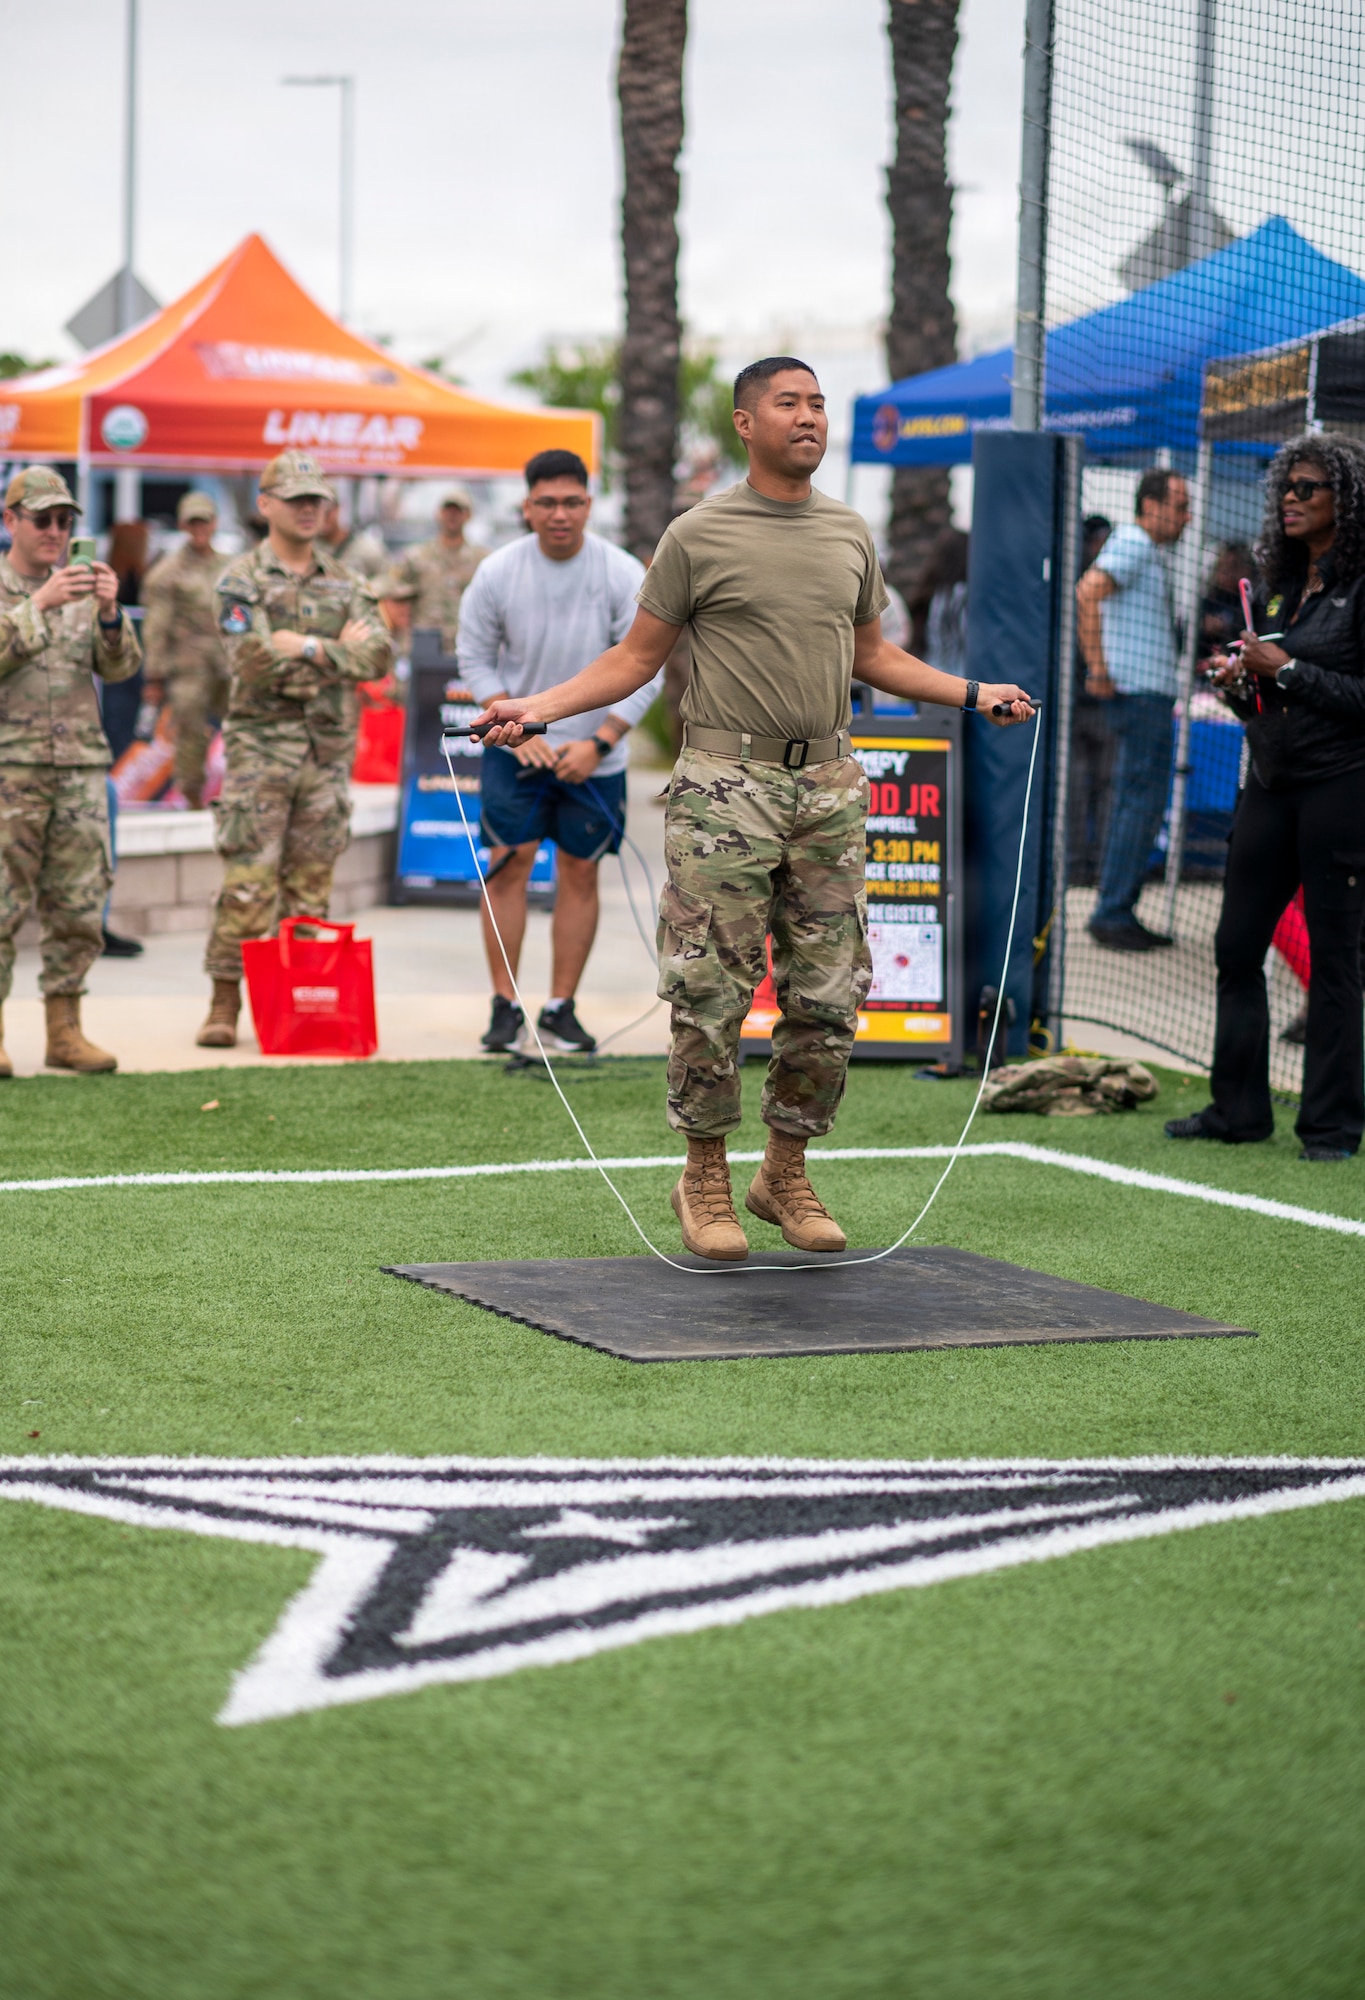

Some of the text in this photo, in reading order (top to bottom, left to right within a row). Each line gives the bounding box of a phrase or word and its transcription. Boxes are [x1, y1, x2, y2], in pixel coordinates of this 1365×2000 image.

[263, 409, 423, 450] LINEAR
[905, 784, 940, 817] JR
[872, 839, 940, 862] 3:30 PM
[887, 864, 940, 882] CENTER
[867, 903, 938, 923] REGISTER
